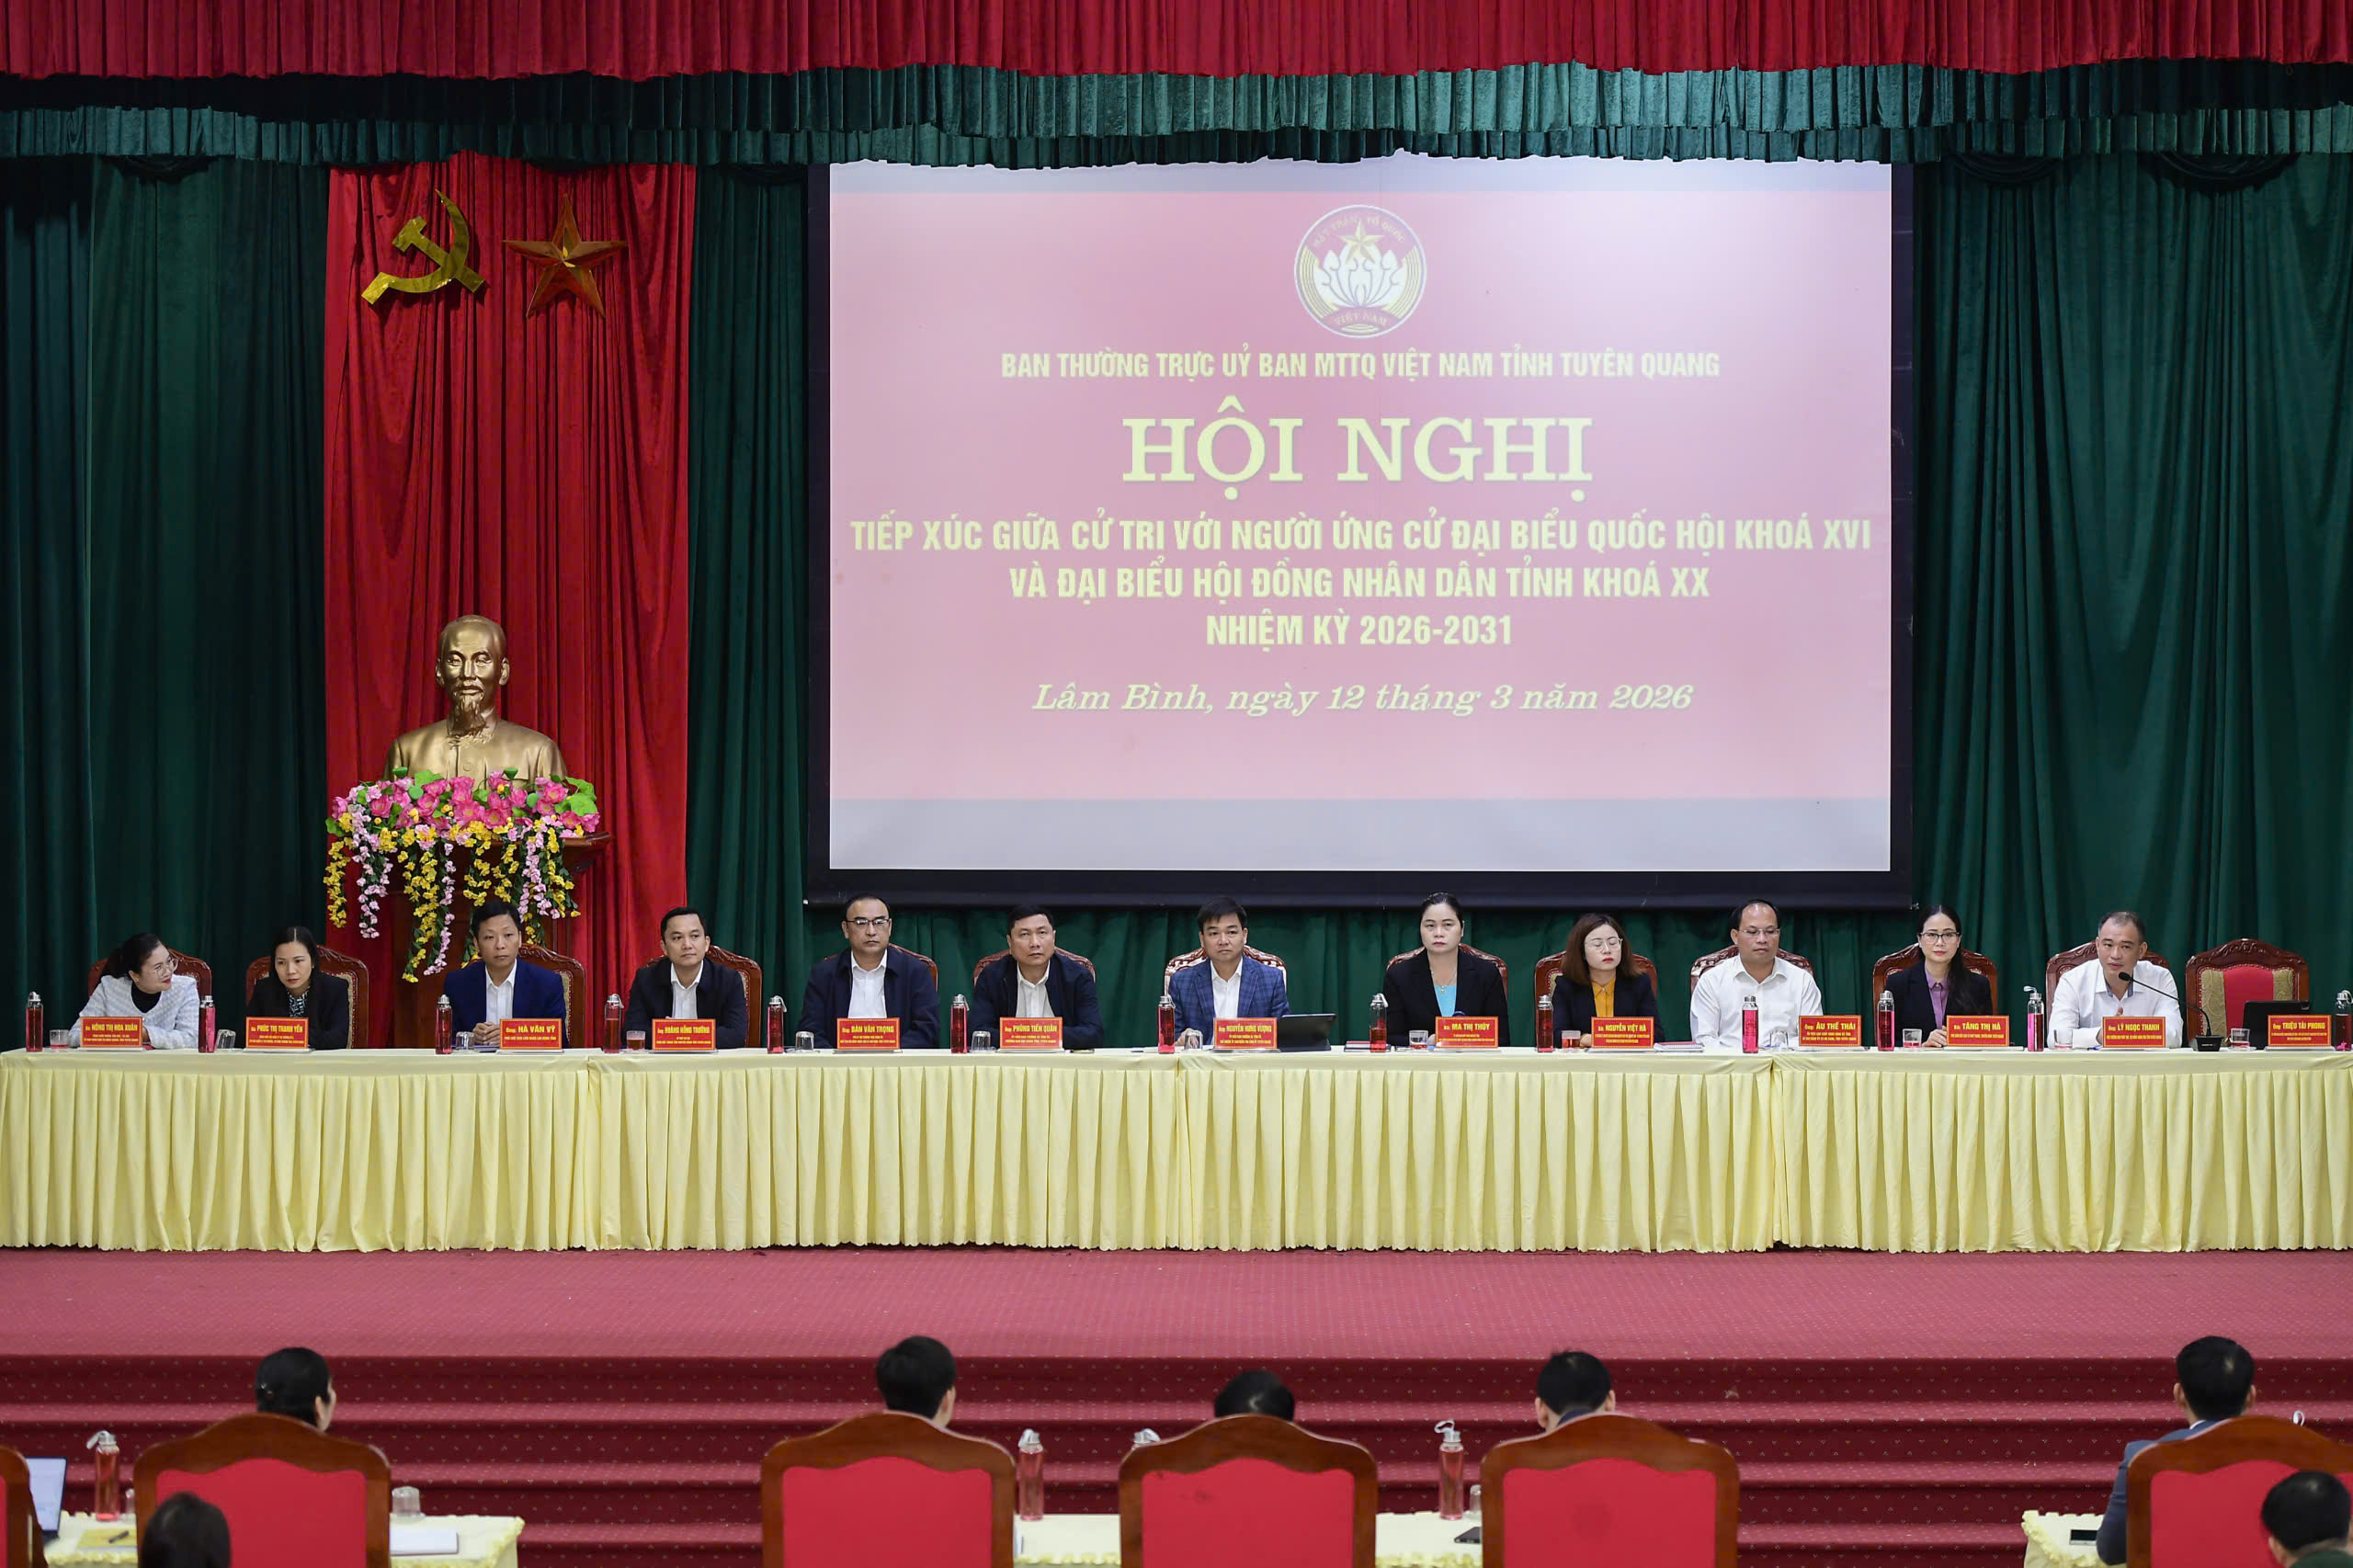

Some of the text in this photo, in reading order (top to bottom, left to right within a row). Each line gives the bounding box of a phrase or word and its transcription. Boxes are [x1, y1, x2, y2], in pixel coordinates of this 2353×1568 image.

[1002, 342, 1721, 382] BAN THƯỜNG TRỰC UỶ BAN MTTQ VIỆT NAM TỈNH TUYÊN QUANG
[1122, 394, 1594, 503] HỘI NGHỊ
[850, 507, 1871, 557] TIẾP XÚC GIỮA CỬ TRI VỚI NGƯỜI ỨNG CỬ ĐẠI BIỂU QUỐC HỘI KHOÁ XVI
[1009, 555, 1710, 606] VÀ ĐẠI BIỂU HỘI ĐỒNG NHÂN DÂN TỈNH KHOÁ XX
[1206, 608, 1512, 653] NHIỆM KỲ 2026-2031
[1031, 682, 1695, 718] Lâm Bình, ngày 12 tháng 3 năm 2026
[1981, 1023, 1990, 1031] THỊ
